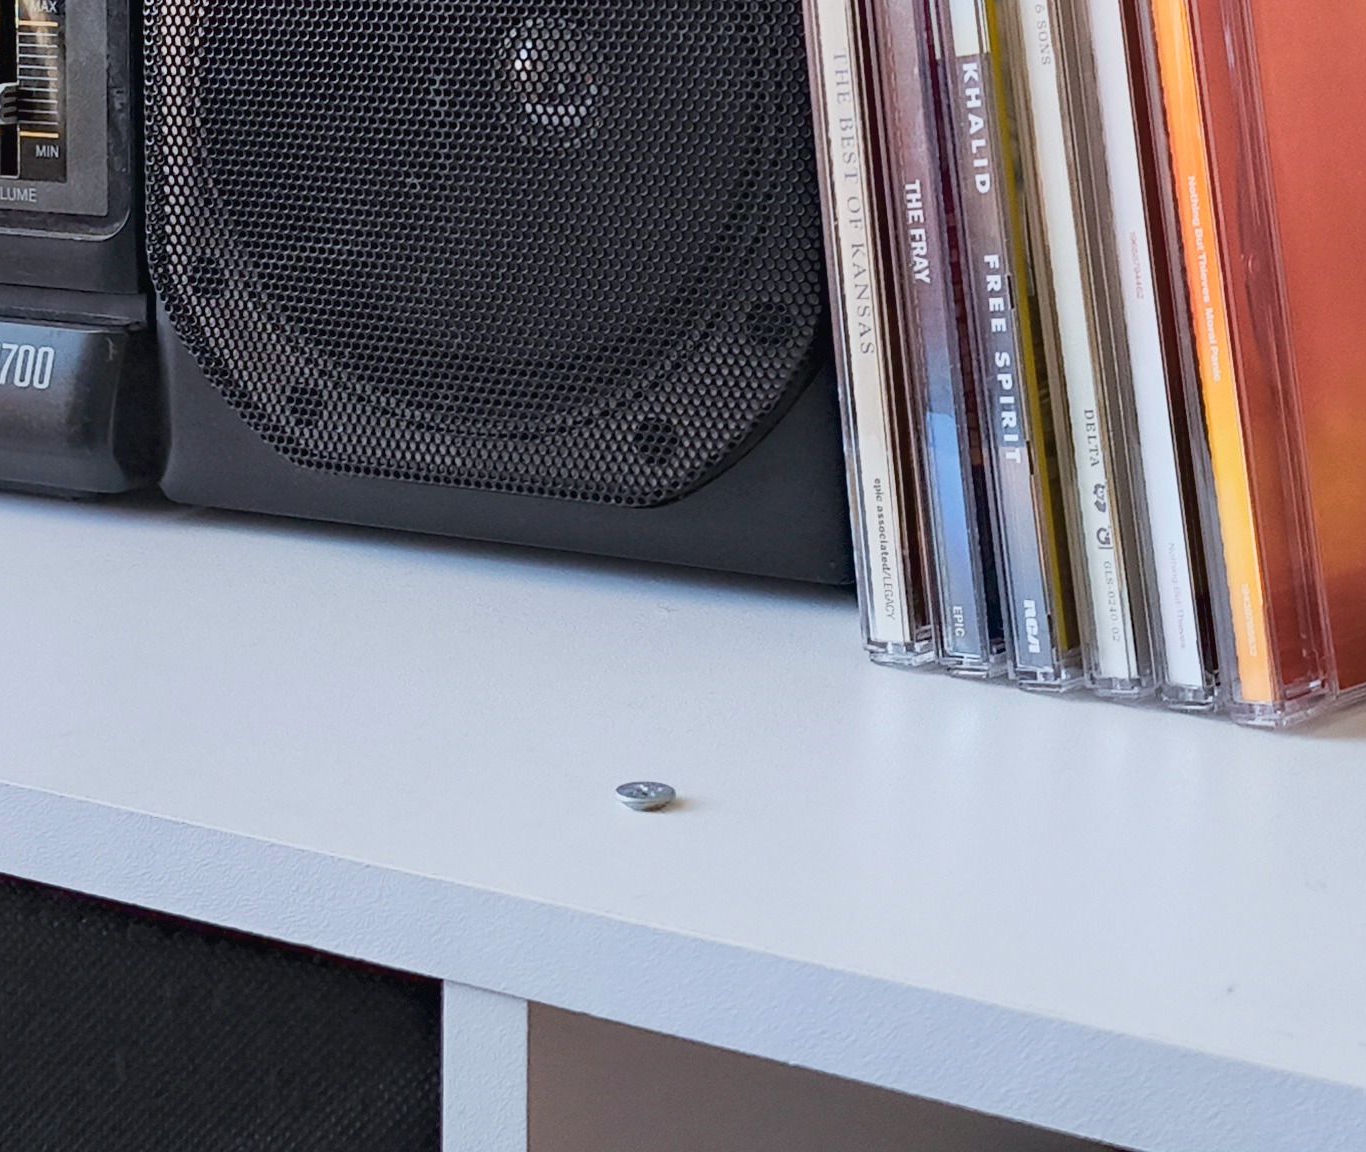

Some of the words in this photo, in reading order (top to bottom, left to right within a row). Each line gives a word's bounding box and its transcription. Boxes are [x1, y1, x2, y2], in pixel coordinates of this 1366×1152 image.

[1037, 20, 1051, 66] SONS
[833, 53, 854, 105] THE
[36, 144, 59, 158] MIN
[839, 116, 859, 180] BEST
[961, 62, 991, 194] KHALID
[847, 195, 863, 232] OF
[904, 179, 924, 225] THE
[1188, 175, 1201, 227] Nothing
[909, 228, 931, 284] FRAY
[1195, 228, 1204, 255] But
[850, 241, 875, 355] KANSAS
[983, 254, 1008, 333] FREE
[1198, 254, 1210, 304] Thieves
[1204, 307, 1216, 345] Moral
[1210, 345, 1222, 383] Panic
[994, 351, 1021, 463] SPIRIT
[1083, 408, 1100, 468] DELTA
[874, 477, 883, 503] epic
[877, 505, 896, 621] associated/LEGACY
[952, 606, 965, 637] EPIC
[1023, 599, 1041, 654] RCA
